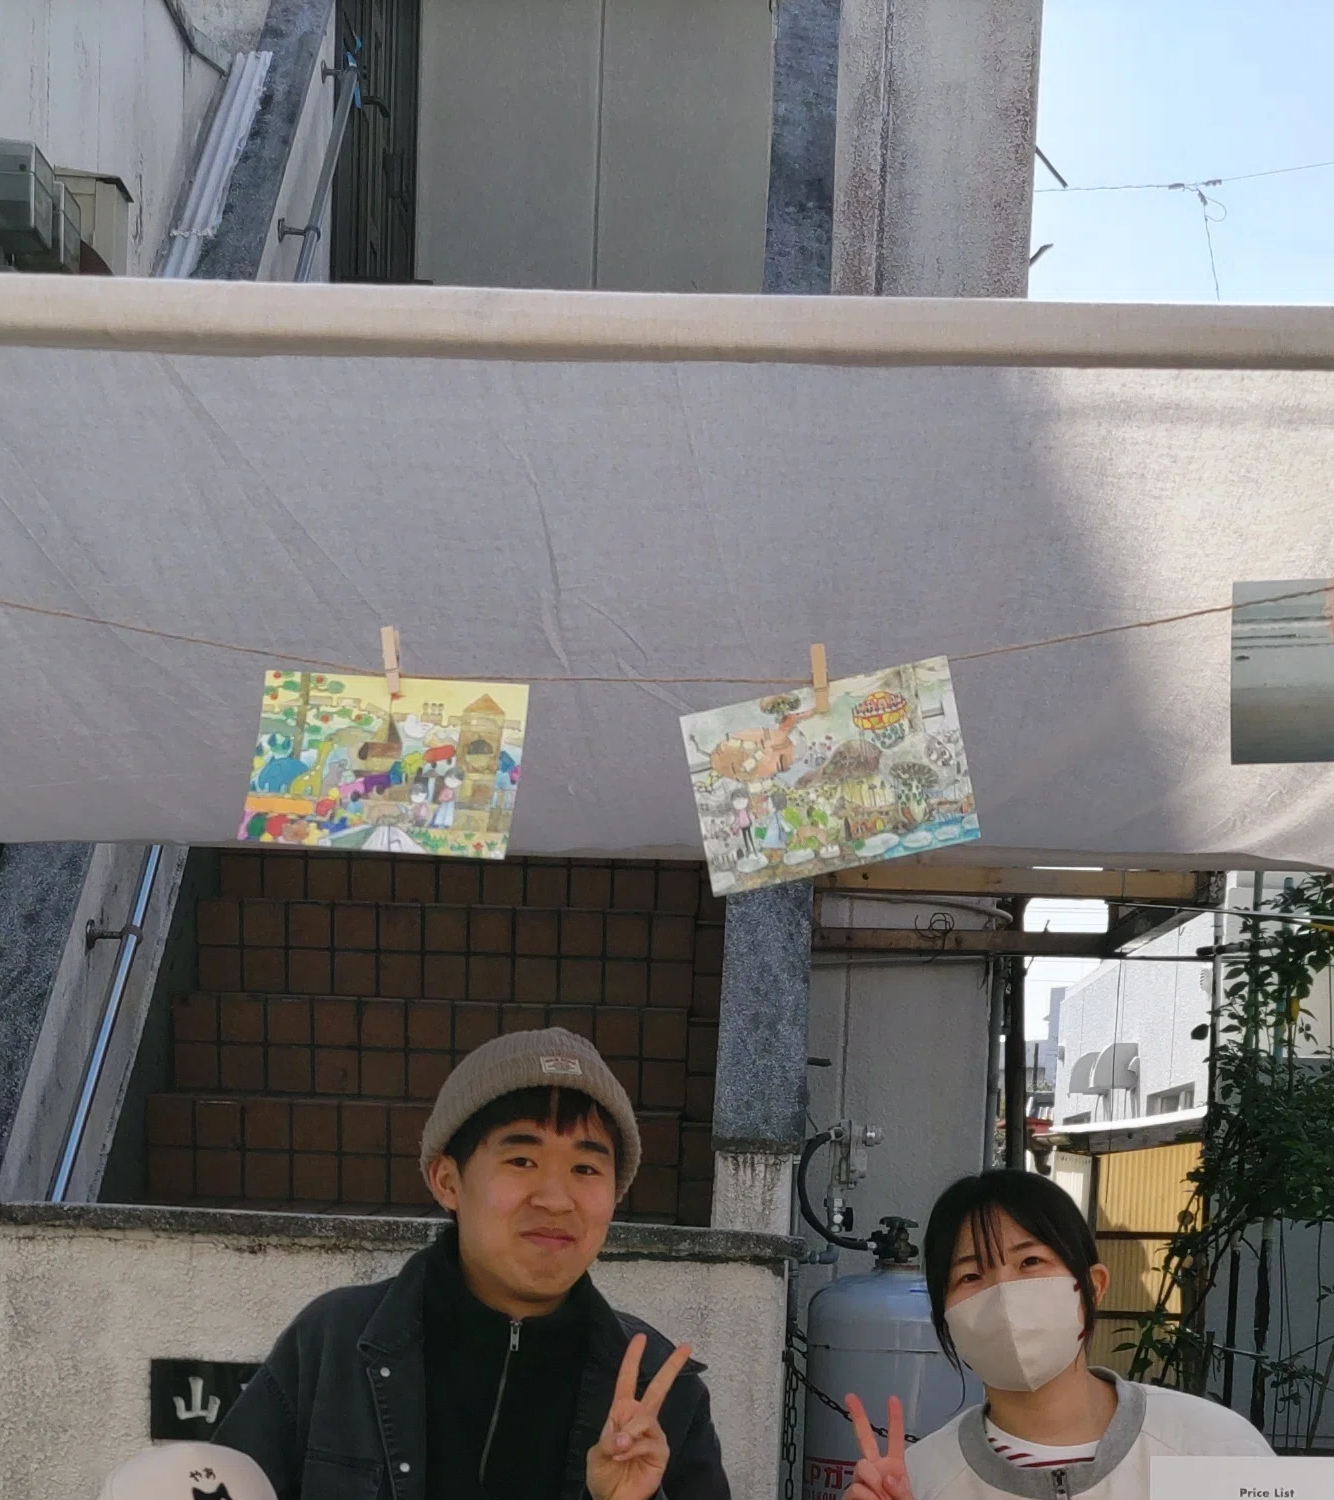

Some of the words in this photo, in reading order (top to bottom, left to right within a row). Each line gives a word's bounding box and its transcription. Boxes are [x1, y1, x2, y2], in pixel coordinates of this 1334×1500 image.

[172, 1376, 229, 1424] 山
[188, 1467, 216, 1483] やあ
[1239, 1488, 1270, 1498] Price
[1274, 1488, 1295, 1498] List
